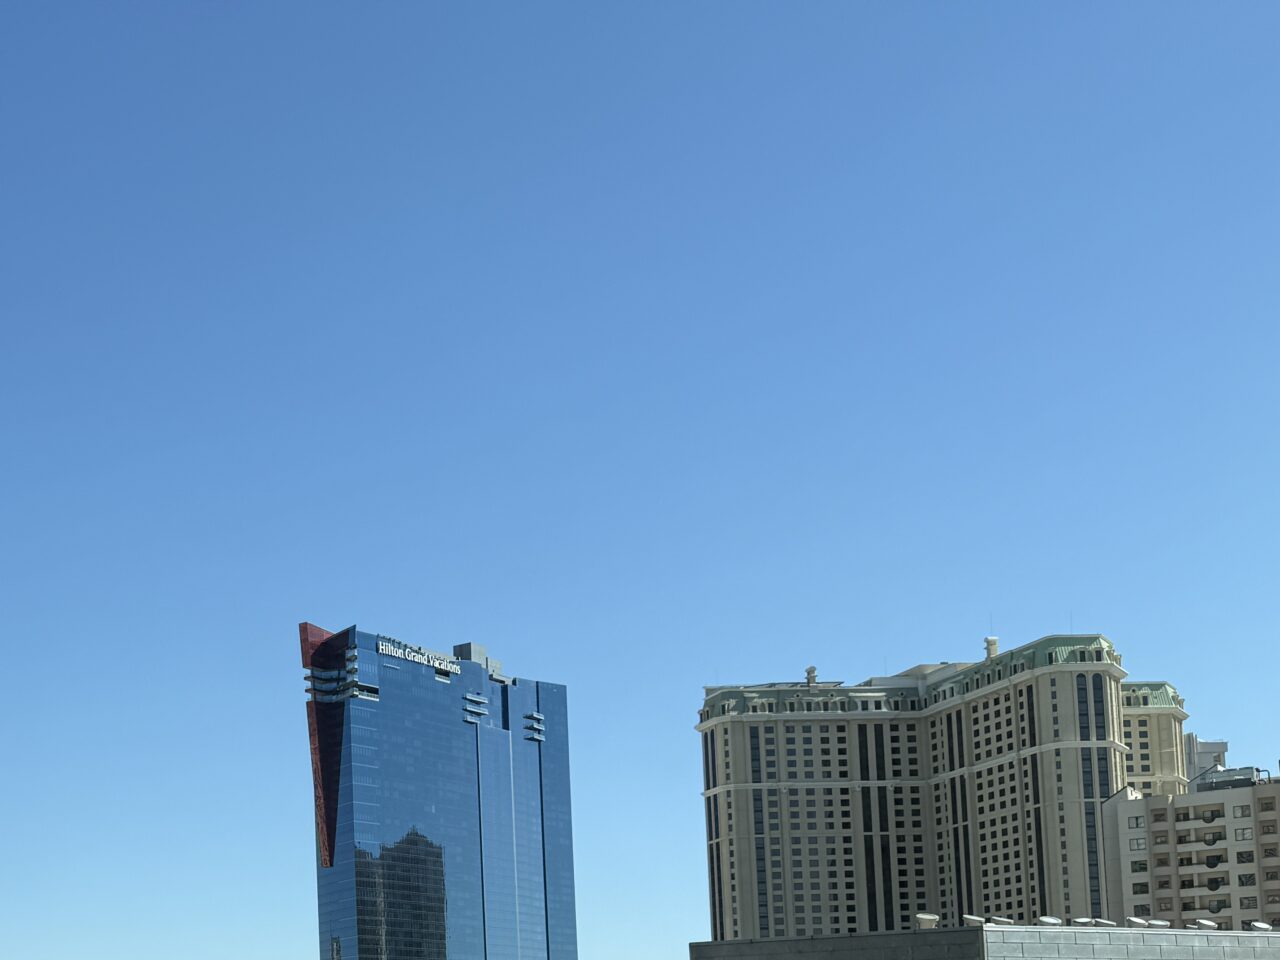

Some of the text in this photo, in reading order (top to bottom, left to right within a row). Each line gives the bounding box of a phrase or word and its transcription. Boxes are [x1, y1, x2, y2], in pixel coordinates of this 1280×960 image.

[378, 641, 461, 674] Hilton Grand Vacations
